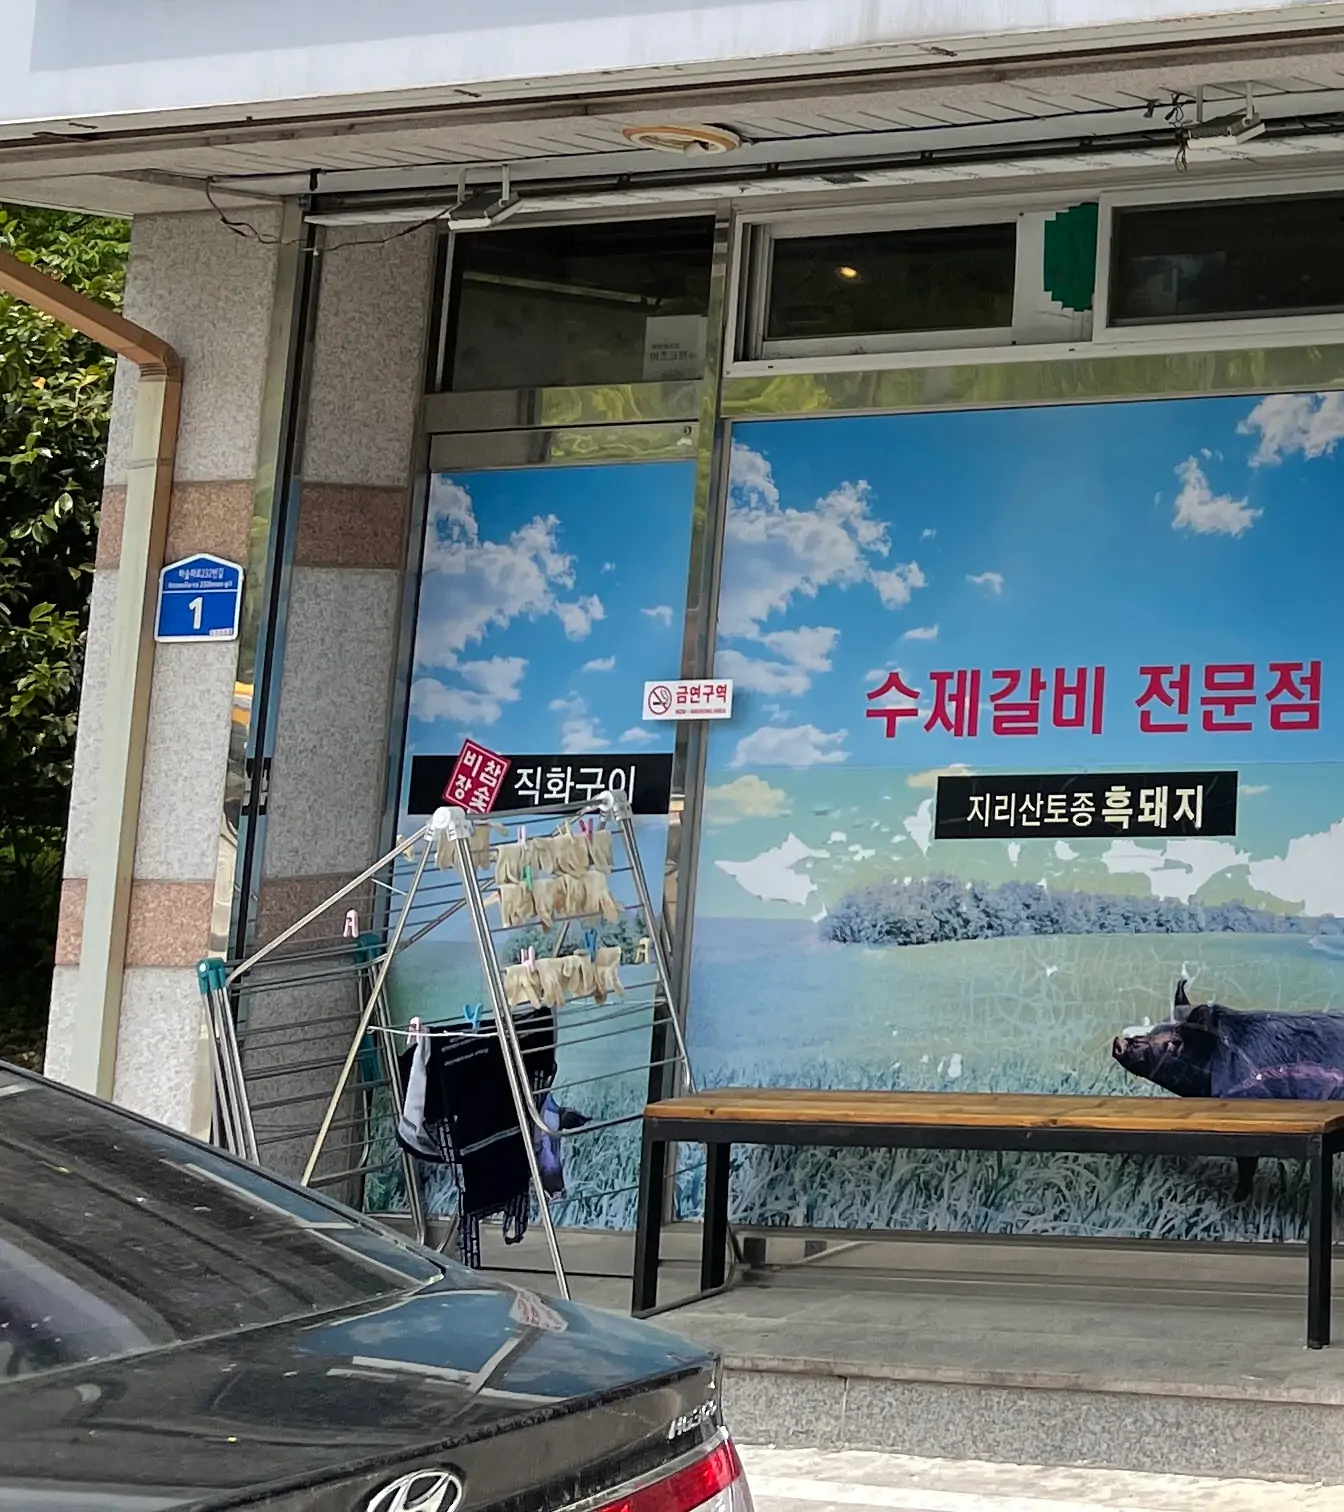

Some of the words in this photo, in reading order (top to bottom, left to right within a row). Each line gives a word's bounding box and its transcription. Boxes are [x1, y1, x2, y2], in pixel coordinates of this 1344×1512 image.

[188, 596, 203, 630] 1
[676, 684, 727, 704] 금연구역
[865, 664, 1106, 739] 수제갈비
[1134, 660, 1323, 734] 전문점
[513, 764, 637, 806] 직화구이
[966, 791, 1096, 829] 지리산토종
[1100, 784, 1205, 831] 흑돼지
